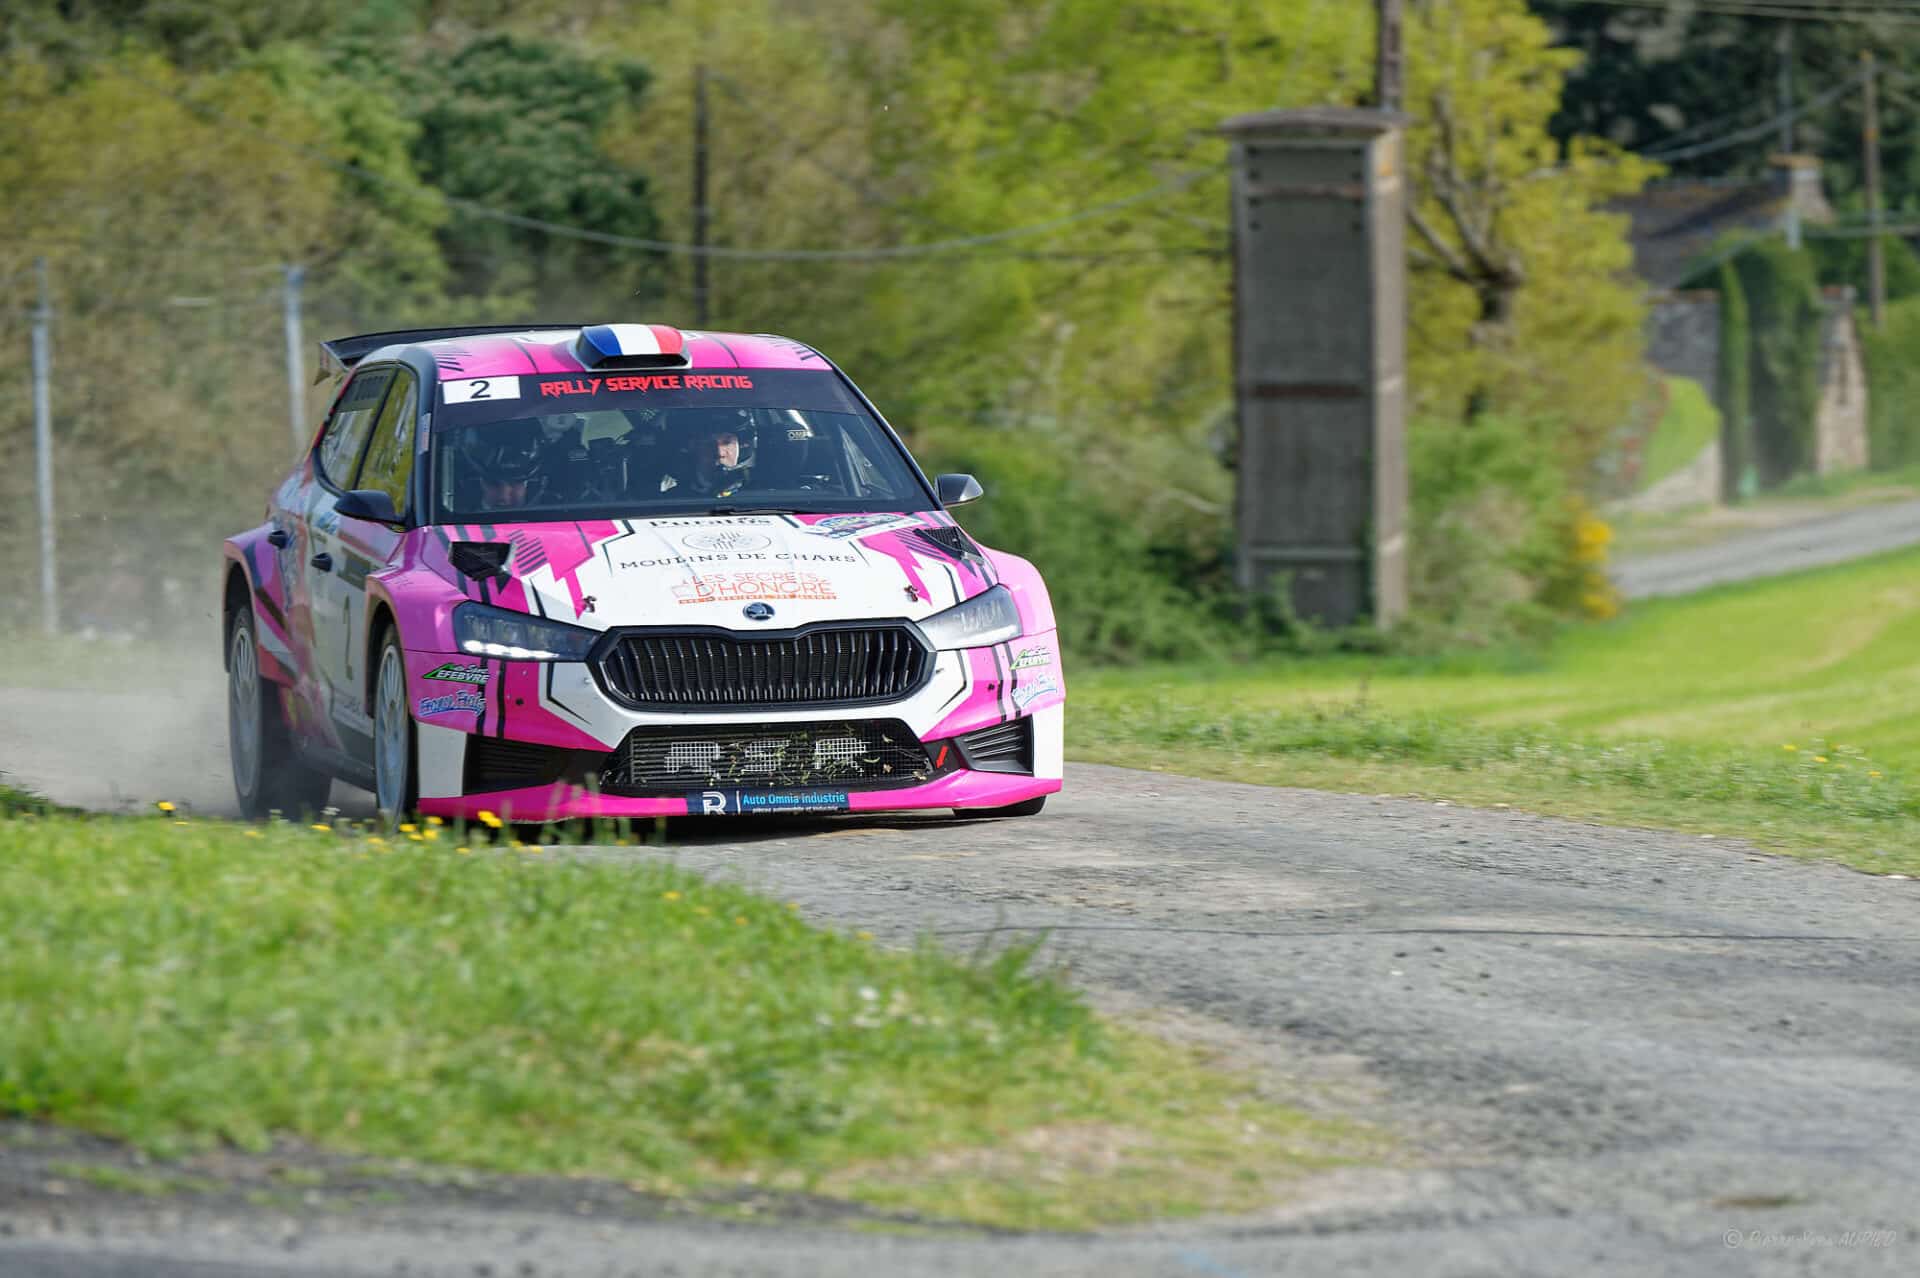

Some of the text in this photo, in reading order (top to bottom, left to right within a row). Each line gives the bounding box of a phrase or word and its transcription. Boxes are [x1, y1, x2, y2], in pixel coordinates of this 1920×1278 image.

[470, 380, 491, 399] 2
[539, 375, 753, 398] RALLY SERVICE RACING
[620, 552, 857, 569] MOULINS DE CHARS
[692, 571, 821, 584] LES SECRETS
[743, 794, 766, 806] Auto
[768, 793, 799, 805] Omnia
